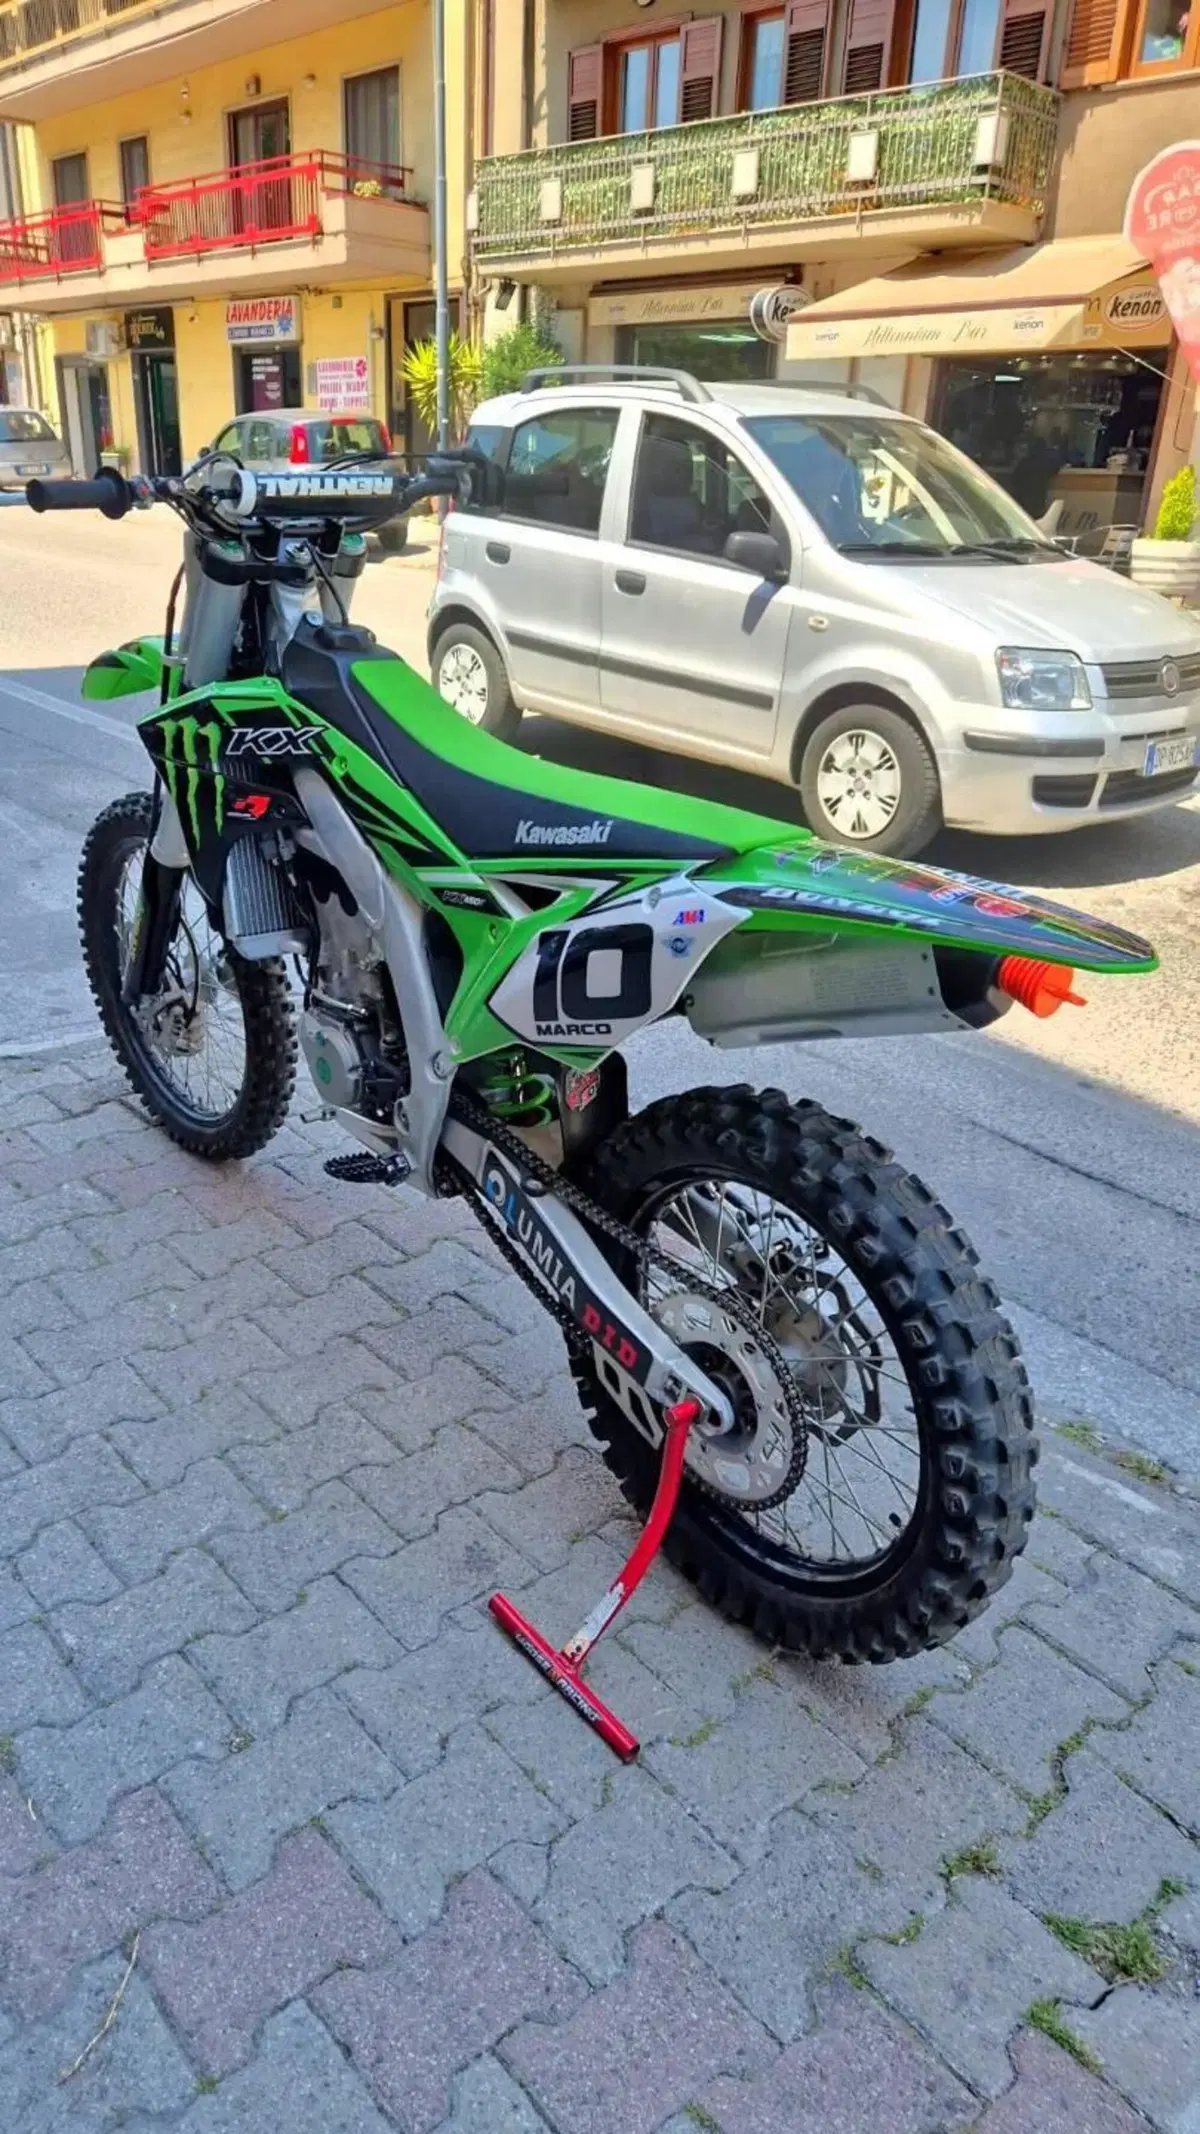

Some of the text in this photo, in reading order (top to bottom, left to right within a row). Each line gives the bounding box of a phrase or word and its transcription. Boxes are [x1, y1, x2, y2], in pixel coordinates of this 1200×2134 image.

[226, 299, 294, 323] LAVANDERIA
[1109, 296, 1162, 318] kenon
[1013, 319, 1044, 331] kenon
[257, 476, 394, 497] RENTHAL
[226, 727, 327, 755] KX
[514, 819, 615, 845] Kawasaki
[533, 922, 654, 1022] 10
[536, 1022, 612, 1037] MARCO
